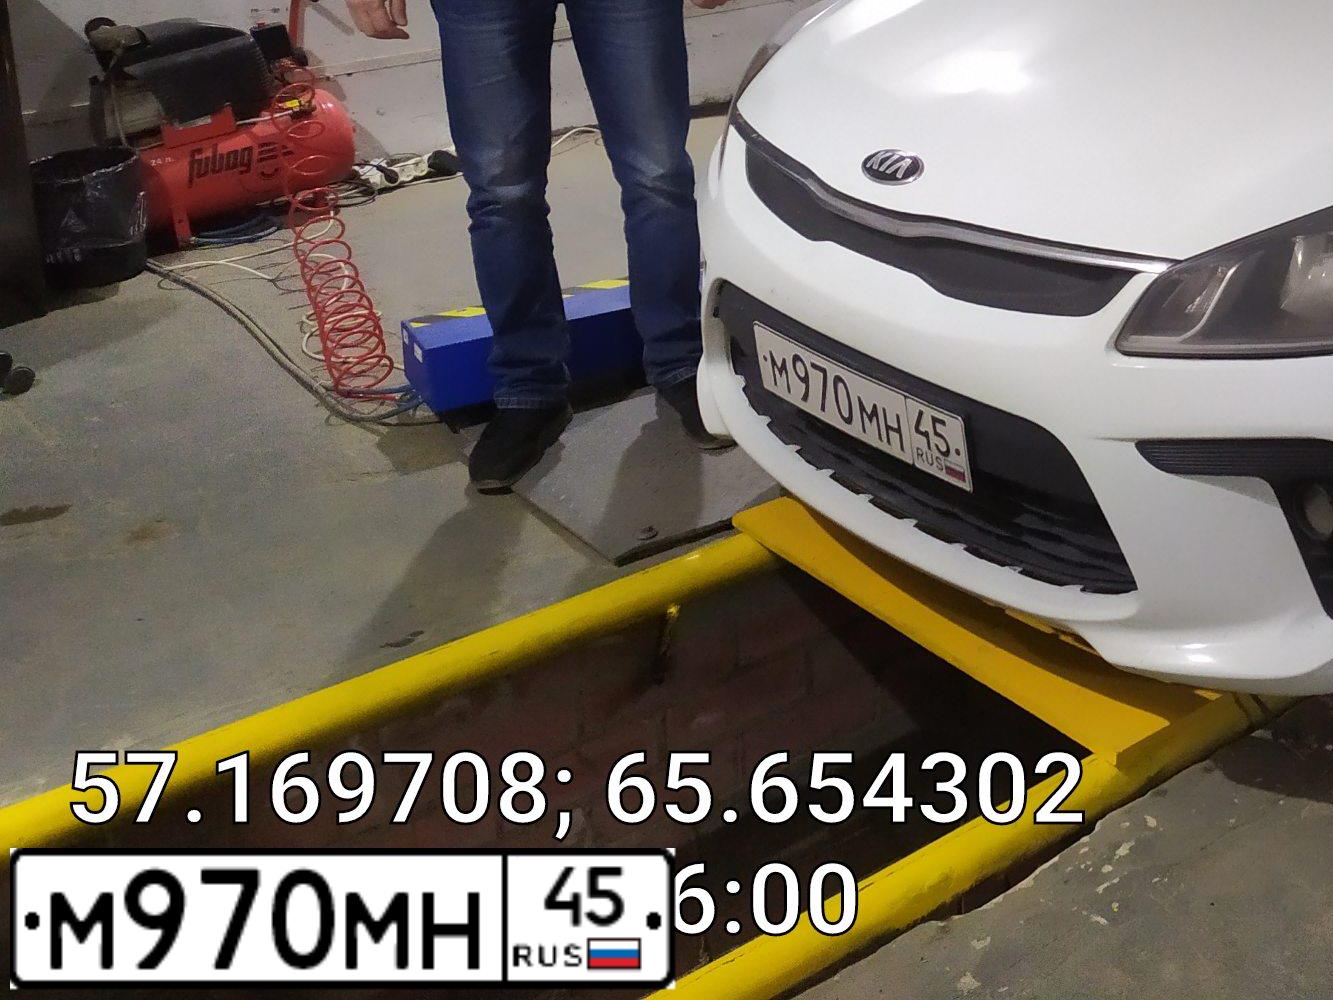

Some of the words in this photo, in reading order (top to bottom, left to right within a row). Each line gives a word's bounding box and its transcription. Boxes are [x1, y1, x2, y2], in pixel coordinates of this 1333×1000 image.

[865, 151, 912, 180] KIA
[914, 409, 950, 458] 45
[916, 446, 944, 471] RUS
